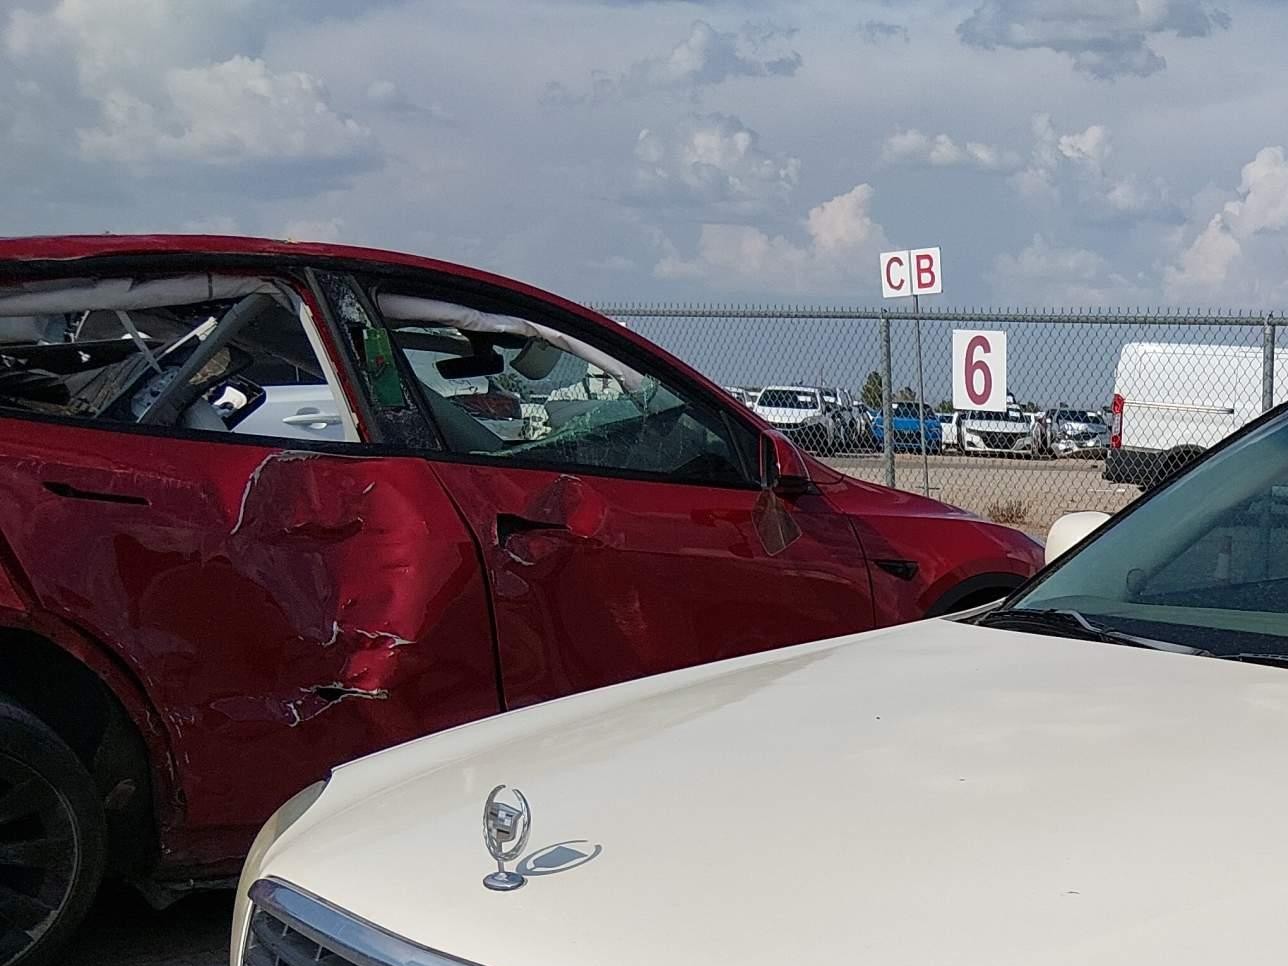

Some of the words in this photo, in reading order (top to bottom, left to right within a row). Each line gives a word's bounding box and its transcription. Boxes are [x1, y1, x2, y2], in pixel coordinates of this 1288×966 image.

[886, 256, 905, 291] C
[916, 254, 936, 289] B
[964, 335, 993, 406] 6
